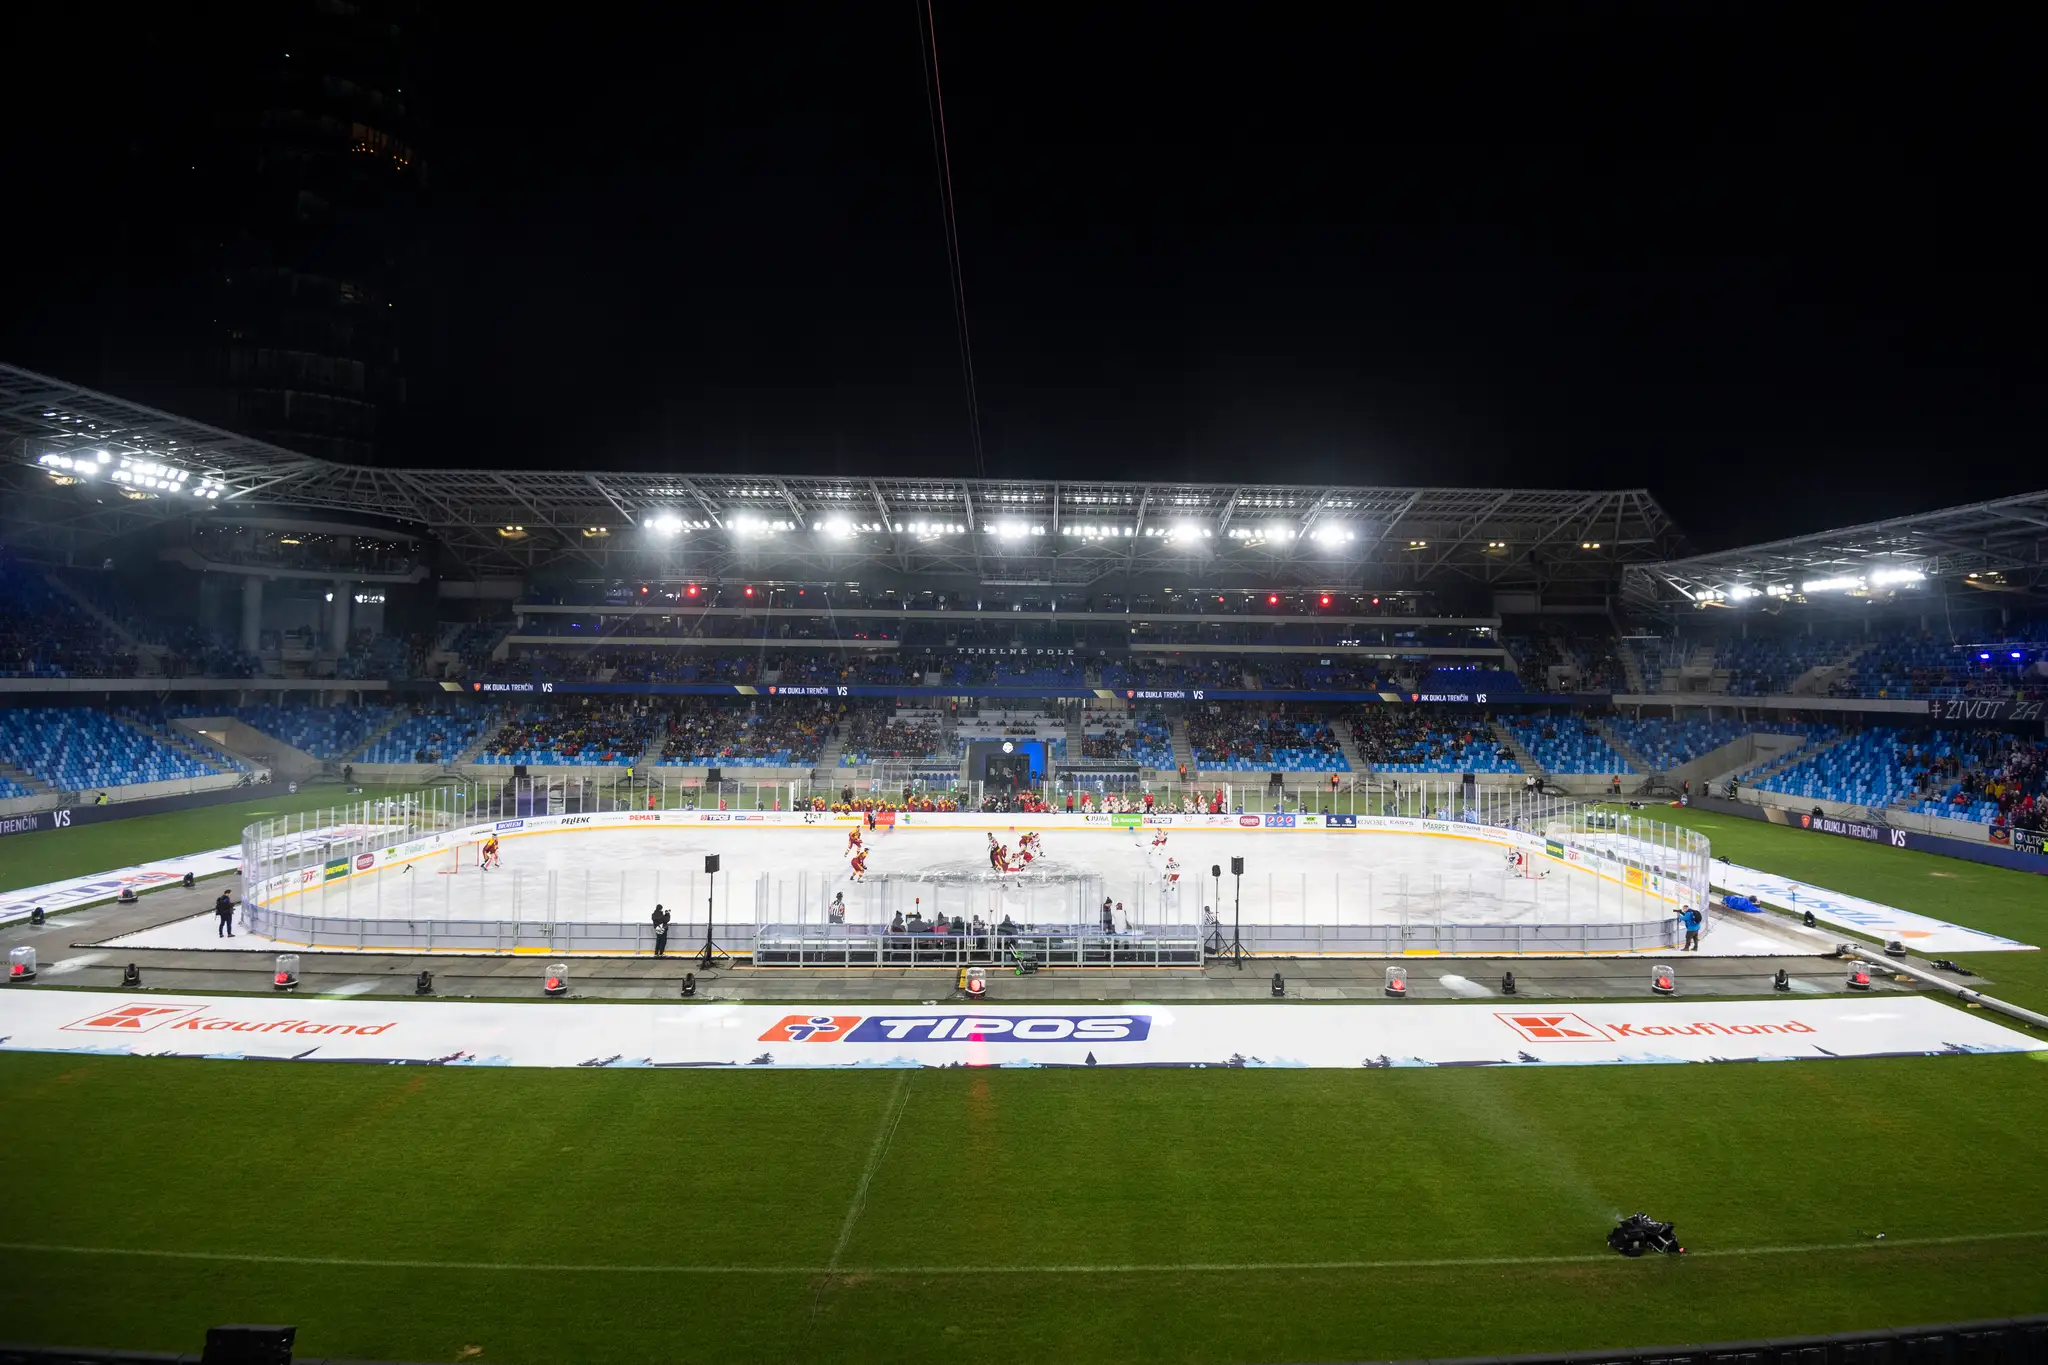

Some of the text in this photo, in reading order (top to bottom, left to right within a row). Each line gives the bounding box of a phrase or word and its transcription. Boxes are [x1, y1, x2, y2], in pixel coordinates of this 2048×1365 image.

[957, 647, 1028, 655] TEHELNÉ
[542, 683, 552, 692] VS
[837, 686, 848, 696] VS
[1194, 690, 1204, 700] VS
[1476, 694, 1486, 703] VS
[53, 810, 71, 828] VS
[1813, 818, 1906, 846] HK DUKLA TRENČÍN VS
[170, 1017, 396, 1036] Kaufland
[880, 1017, 1133, 1040] TIPOS
[1606, 1020, 1817, 1036] Kaufland
